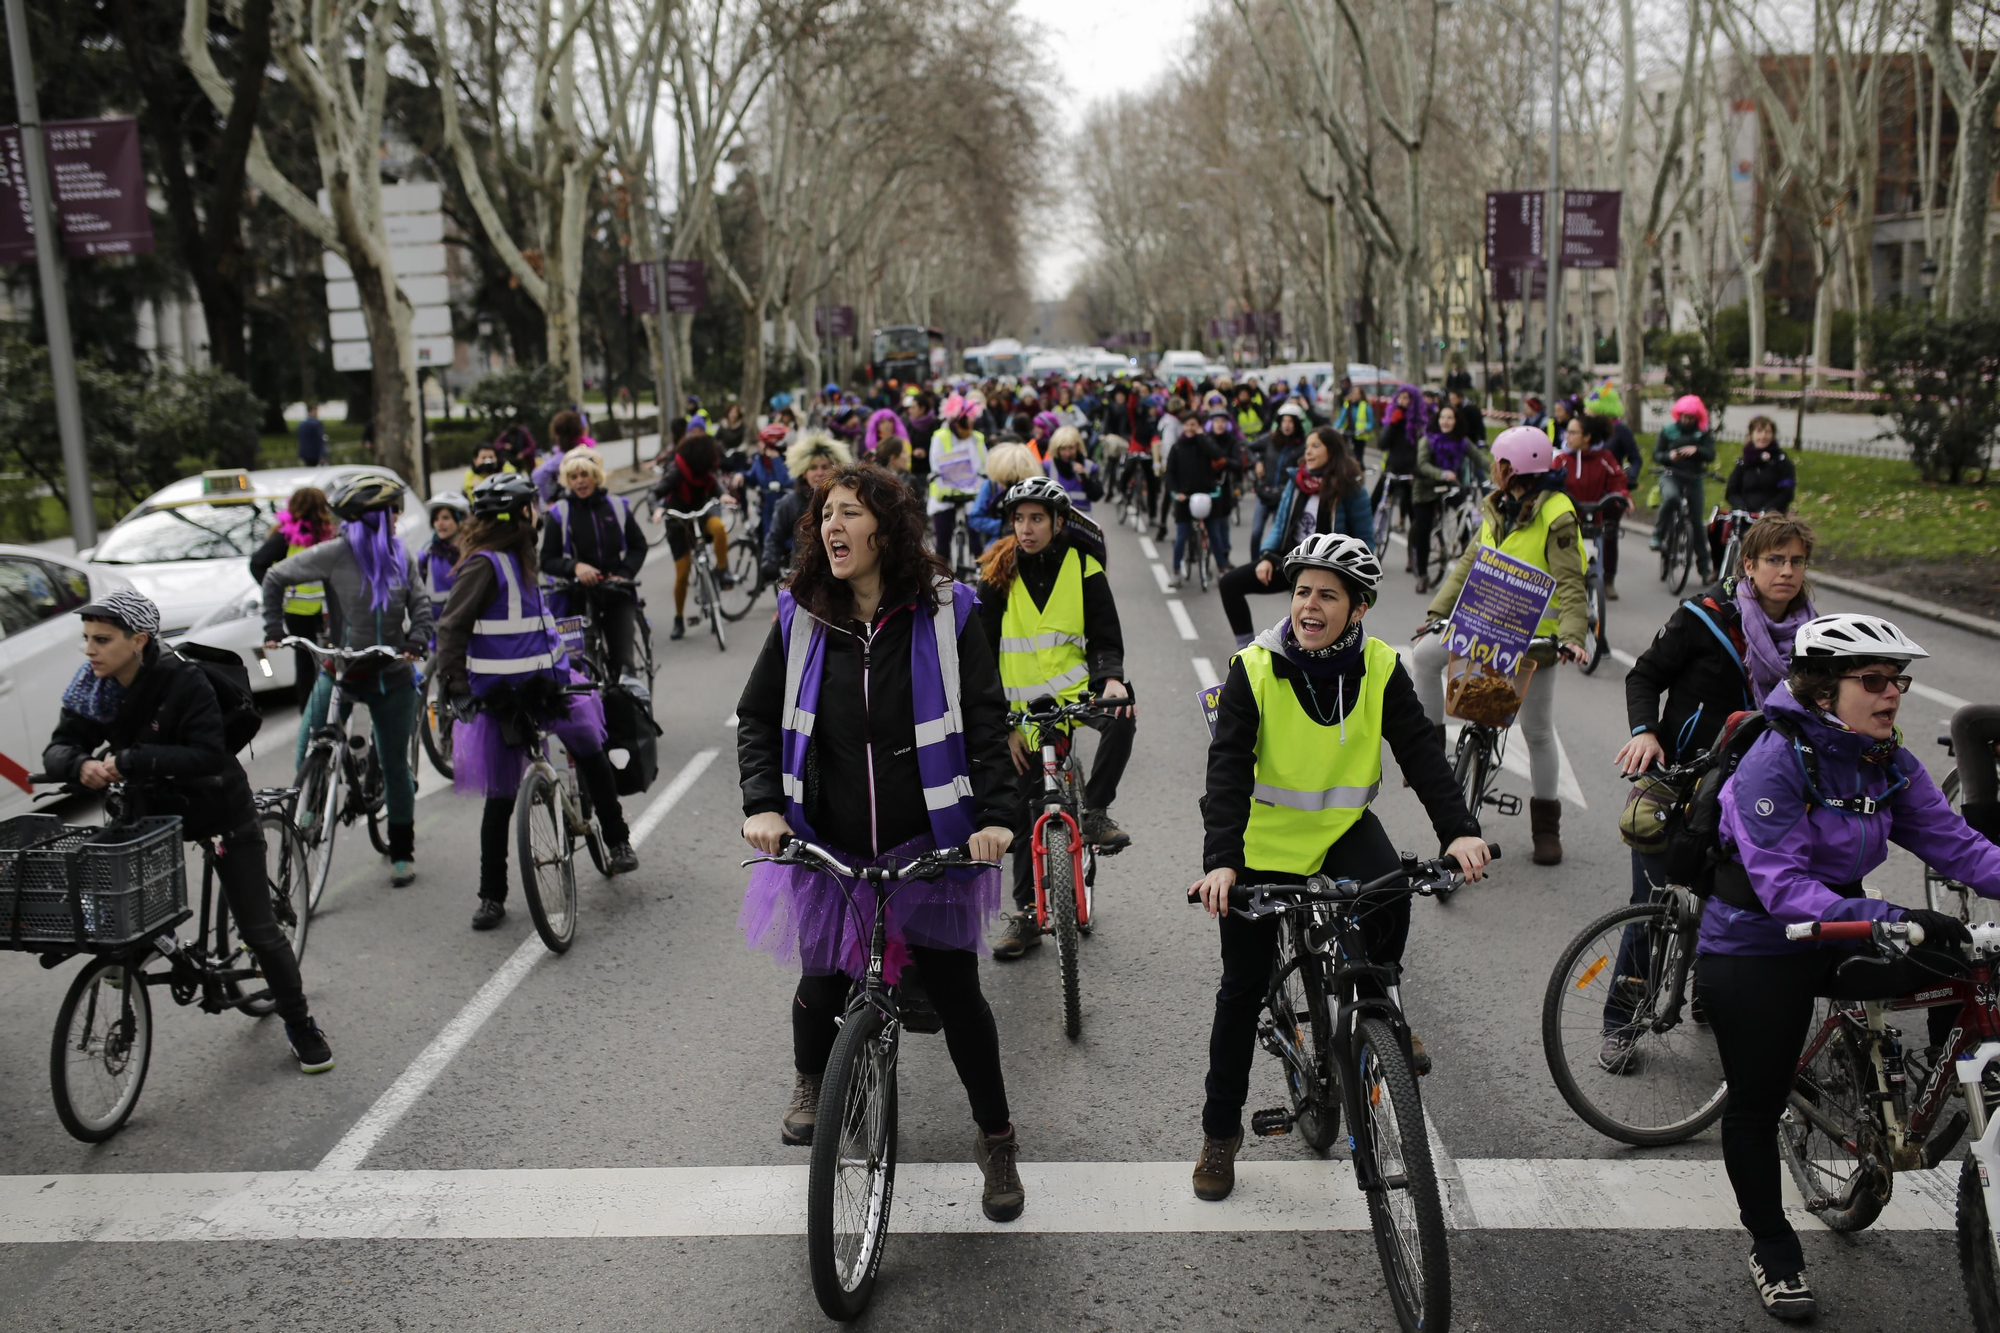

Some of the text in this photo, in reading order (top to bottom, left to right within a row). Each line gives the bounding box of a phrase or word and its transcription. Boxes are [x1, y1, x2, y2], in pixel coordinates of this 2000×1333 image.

[1474, 561, 1505, 581] HUELGA
[1506, 575, 1549, 598] FEMINISTA
[1916, 1027, 1963, 1115] KONA
[883, 1181, 892, 1221] FACTORY
